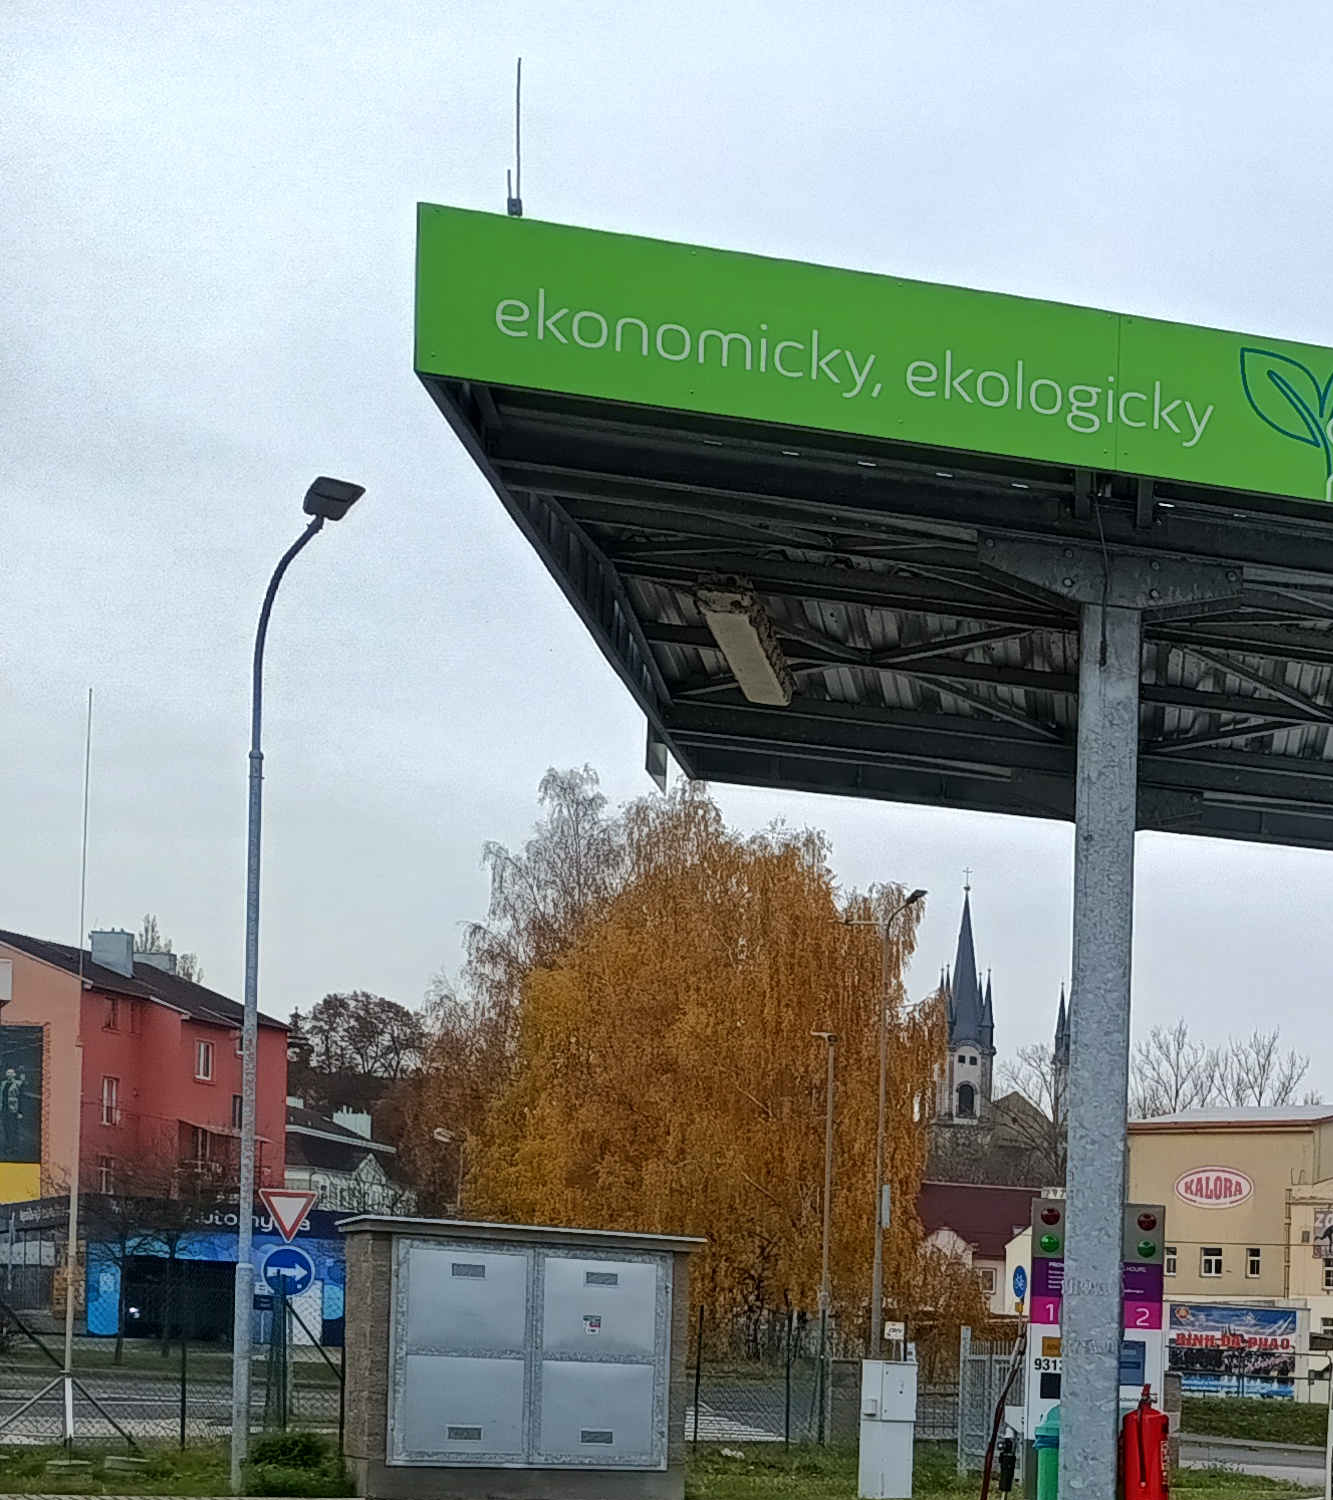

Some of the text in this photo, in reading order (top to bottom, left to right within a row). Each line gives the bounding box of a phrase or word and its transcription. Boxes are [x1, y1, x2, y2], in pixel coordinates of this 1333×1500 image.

[495, 287, 1214, 448] ekonomicky, ekologicky
[1184, 1175, 1243, 1200] KALORA
[1045, 1303, 1055, 1322] 1
[1135, 1307, 1151, 1327] 2
